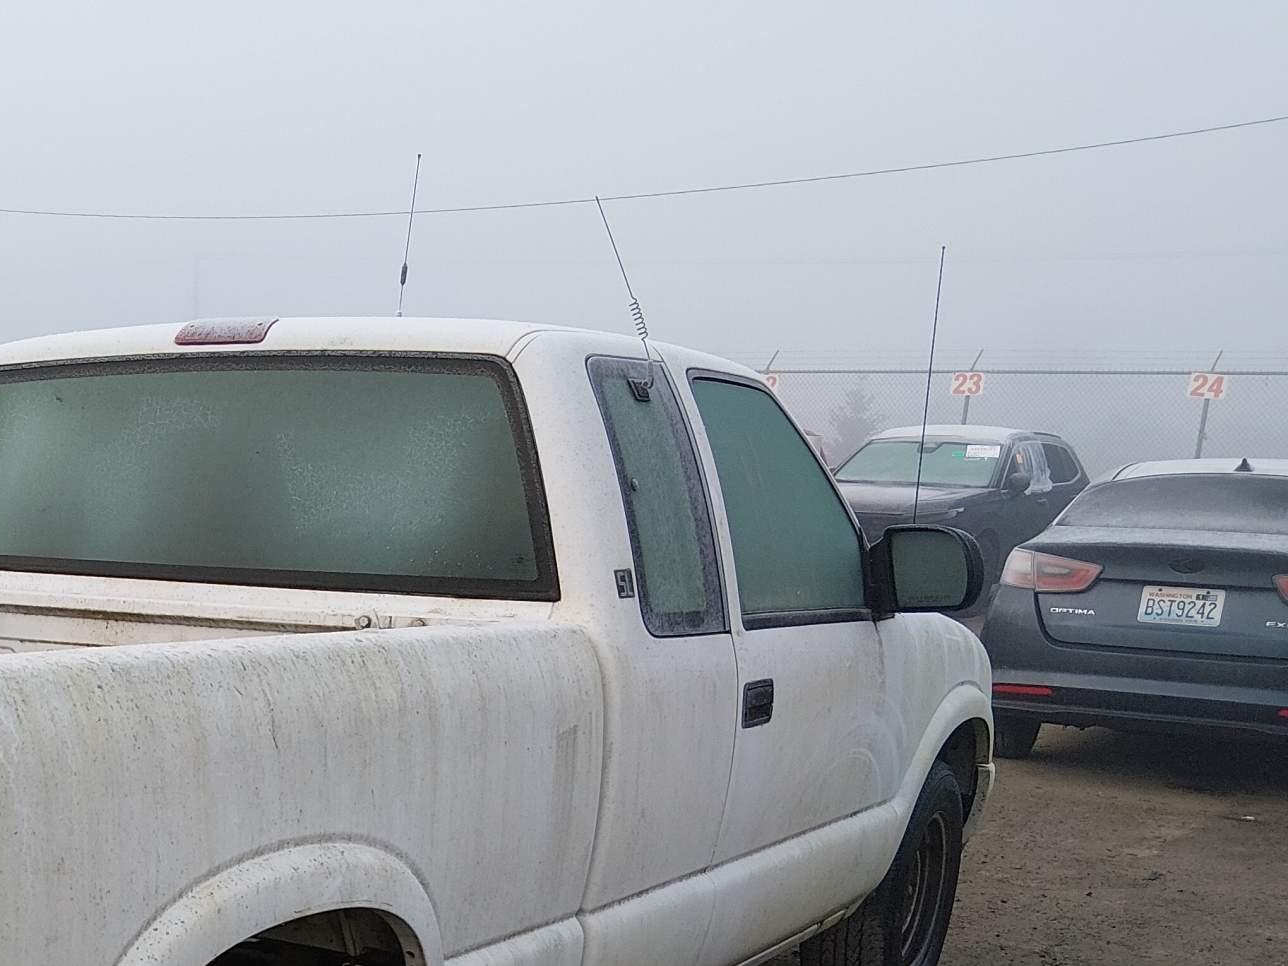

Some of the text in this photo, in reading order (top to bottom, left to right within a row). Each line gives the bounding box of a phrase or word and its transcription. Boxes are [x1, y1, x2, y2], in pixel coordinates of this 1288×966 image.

[952, 373, 983, 395] 23
[1190, 374, 1224, 398] 24
[1148, 591, 1193, 600] WASHINGTON
[1050, 607, 1096, 616] OPTIMA
[1144, 598, 1218, 621] BST9242
